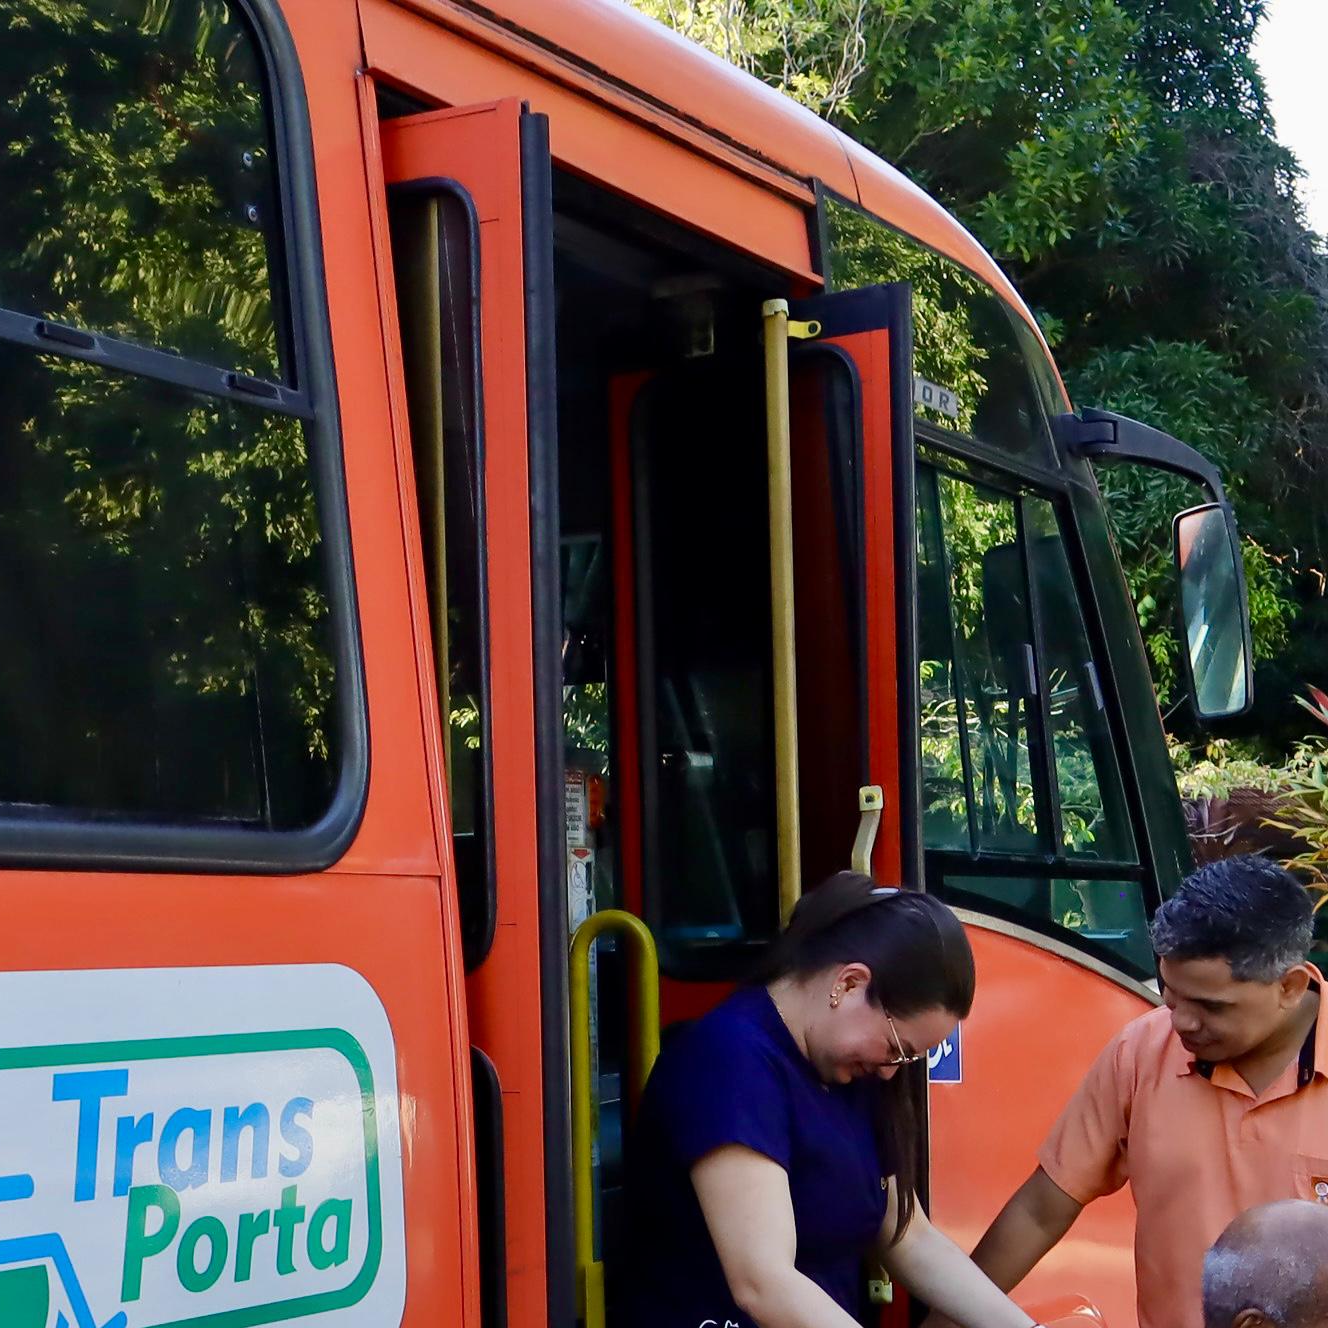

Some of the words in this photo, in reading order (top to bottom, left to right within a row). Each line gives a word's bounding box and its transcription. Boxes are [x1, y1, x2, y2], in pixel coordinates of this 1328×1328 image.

[913, 380, 949, 410] OR
[52, 1068, 315, 1202] Trans
[120, 1184, 354, 1302] Porta
